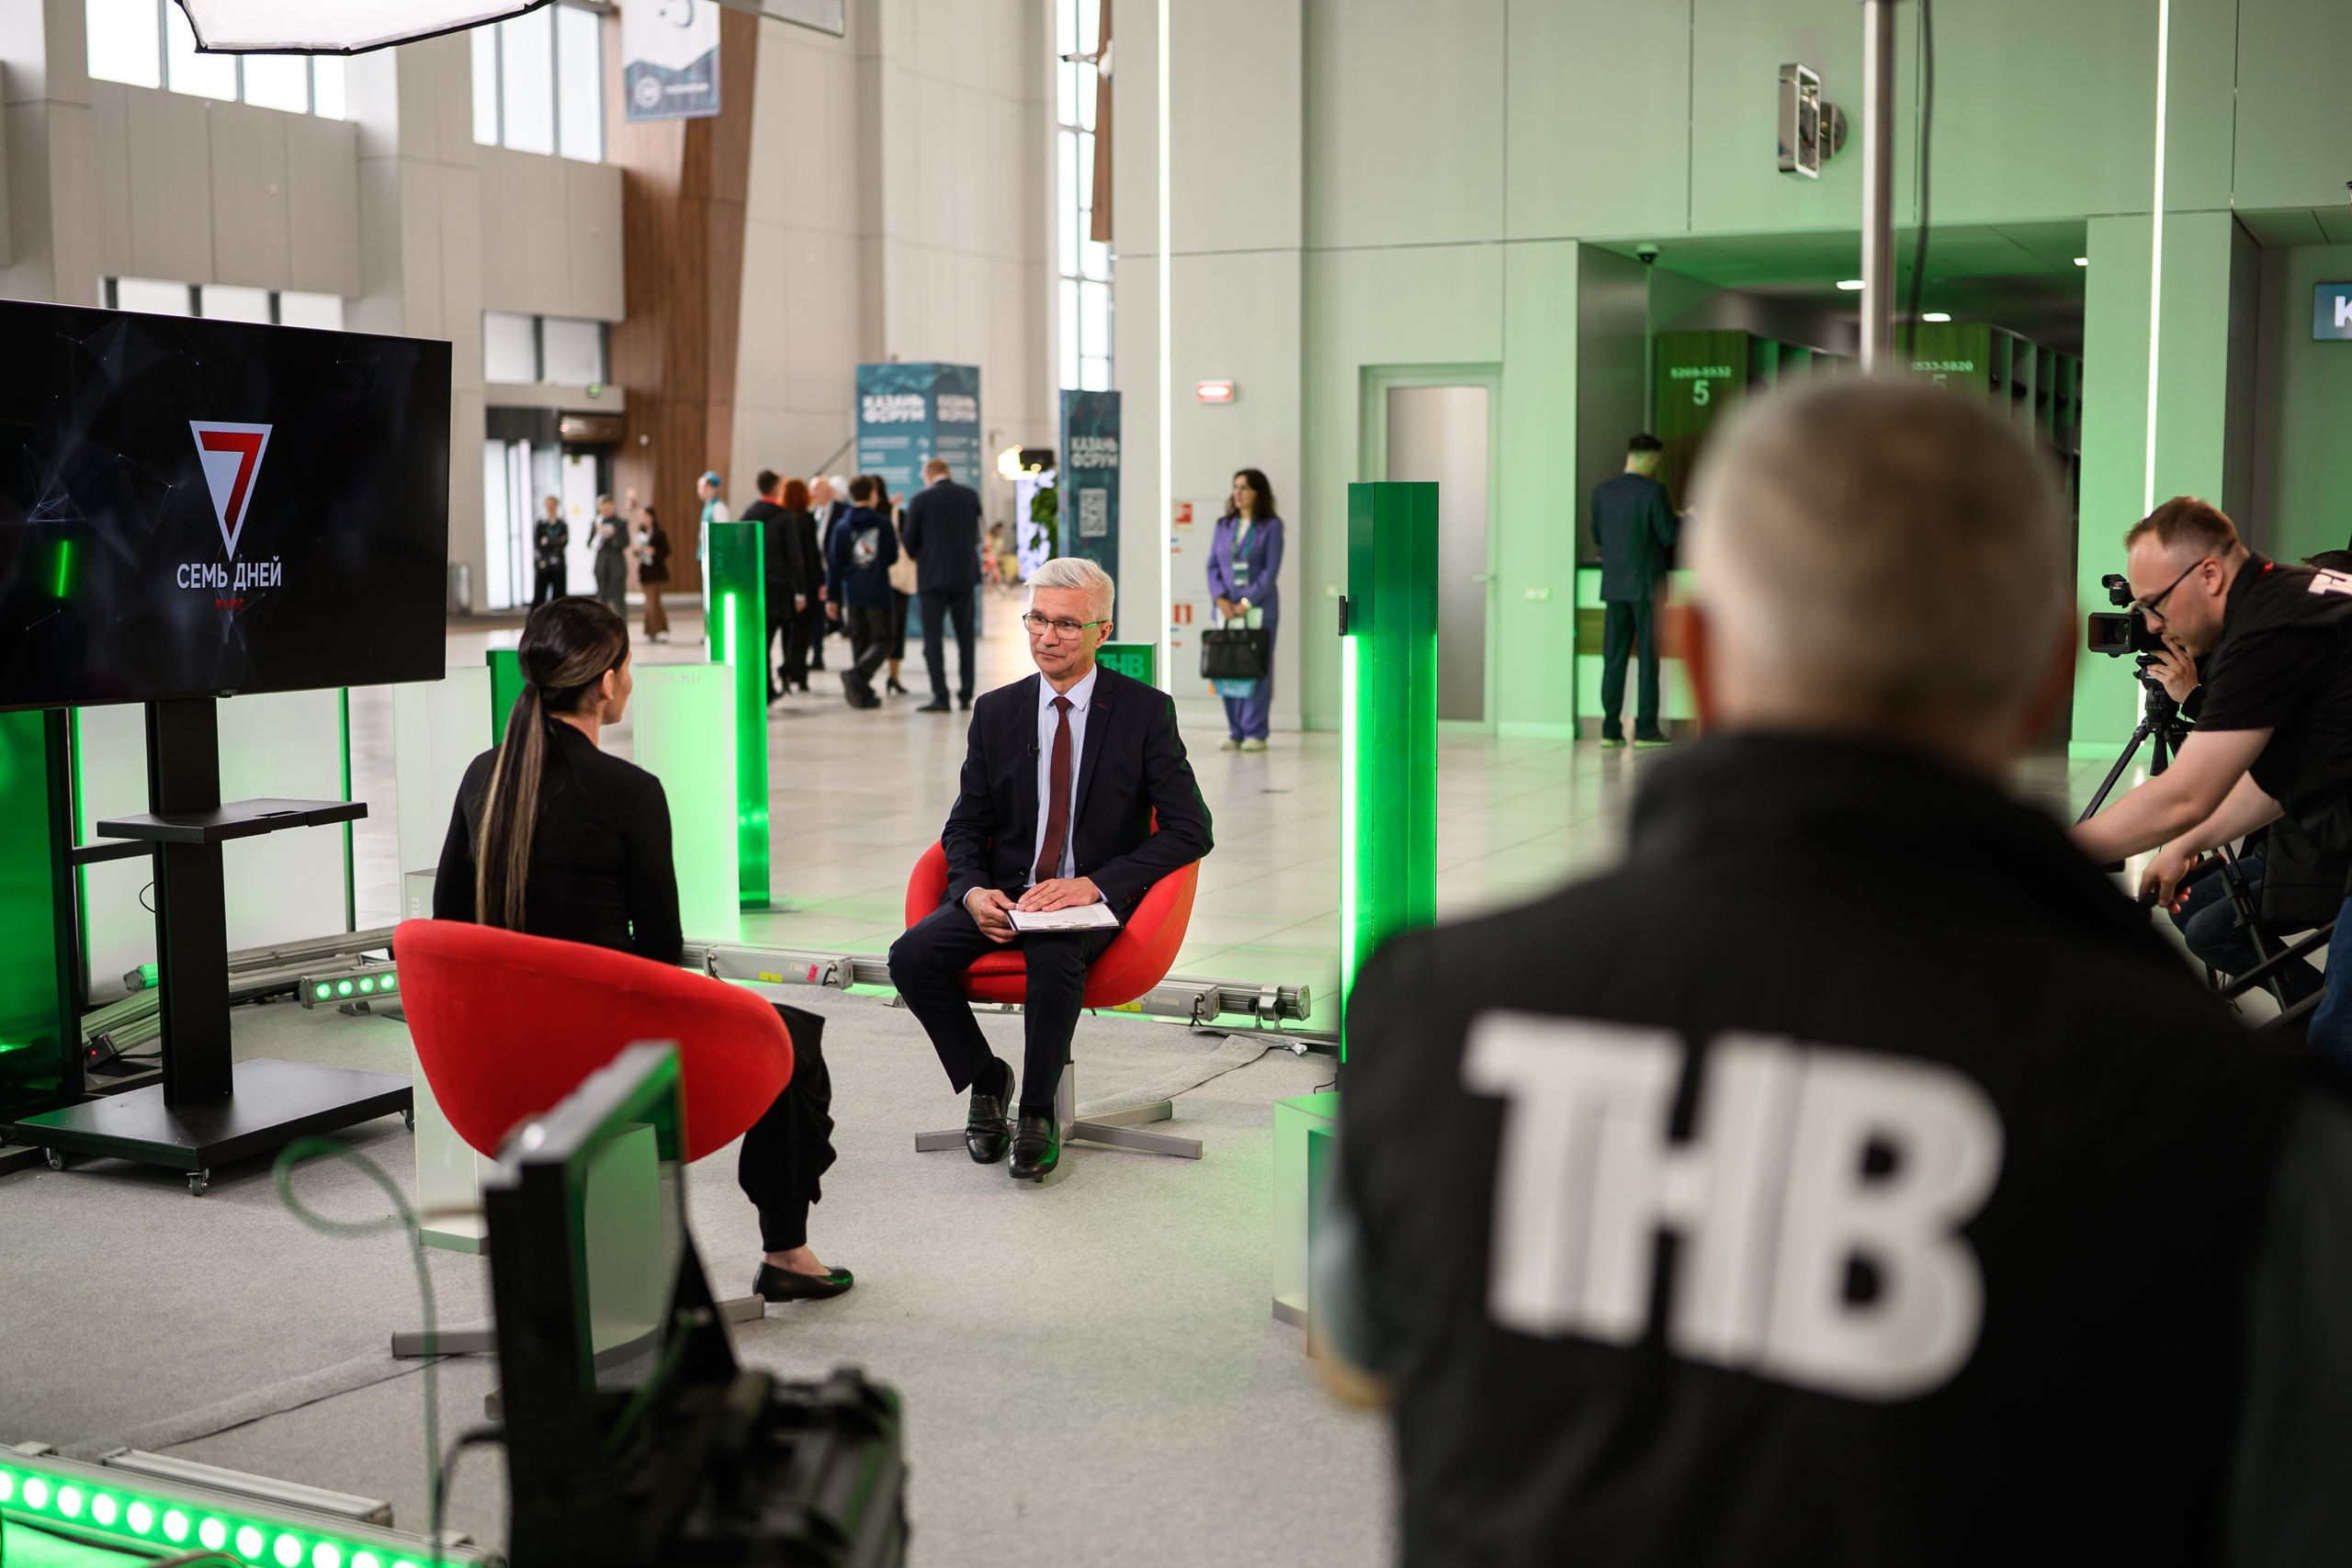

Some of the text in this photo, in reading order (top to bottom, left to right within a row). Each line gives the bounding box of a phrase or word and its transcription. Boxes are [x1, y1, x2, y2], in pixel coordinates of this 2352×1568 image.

[1692, 379, 1710, 405] 5
[176, 555, 282, 592] СЕМЬ ДНЕЙ
[215, 598, 244, 612] ПЛЮС
[1463, 1009, 2005, 1404] ТНВ
